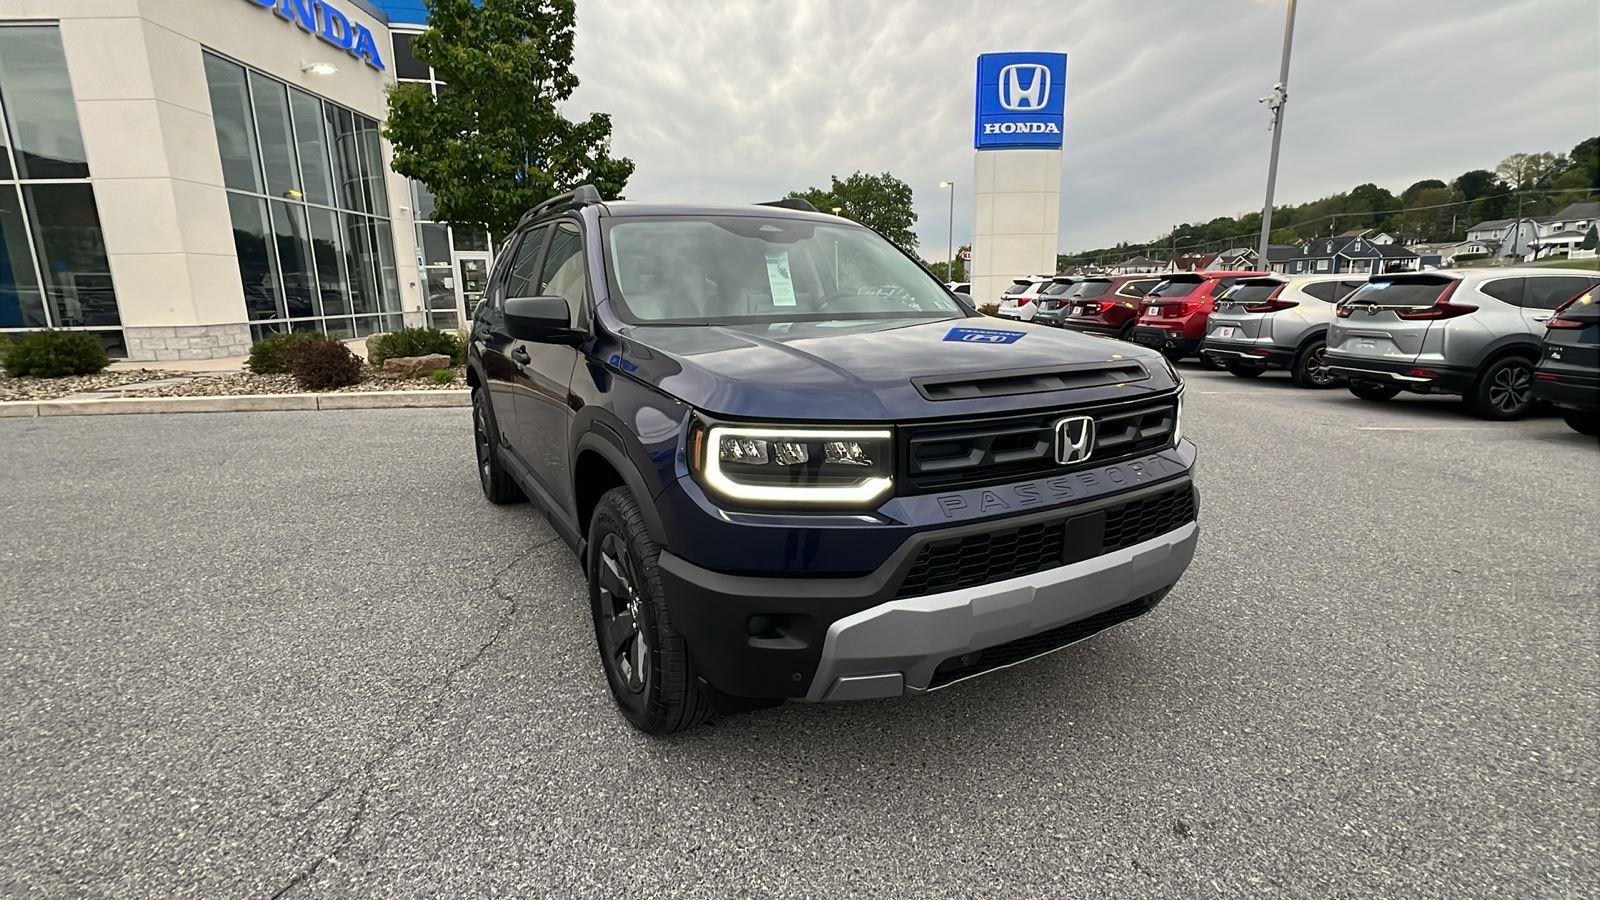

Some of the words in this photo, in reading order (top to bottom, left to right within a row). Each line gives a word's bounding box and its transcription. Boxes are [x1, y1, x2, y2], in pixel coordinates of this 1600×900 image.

[243, 0, 386, 71] NDA
[983, 122, 1060, 134] HONDA
[937, 454, 1170, 518] PASSPORT
